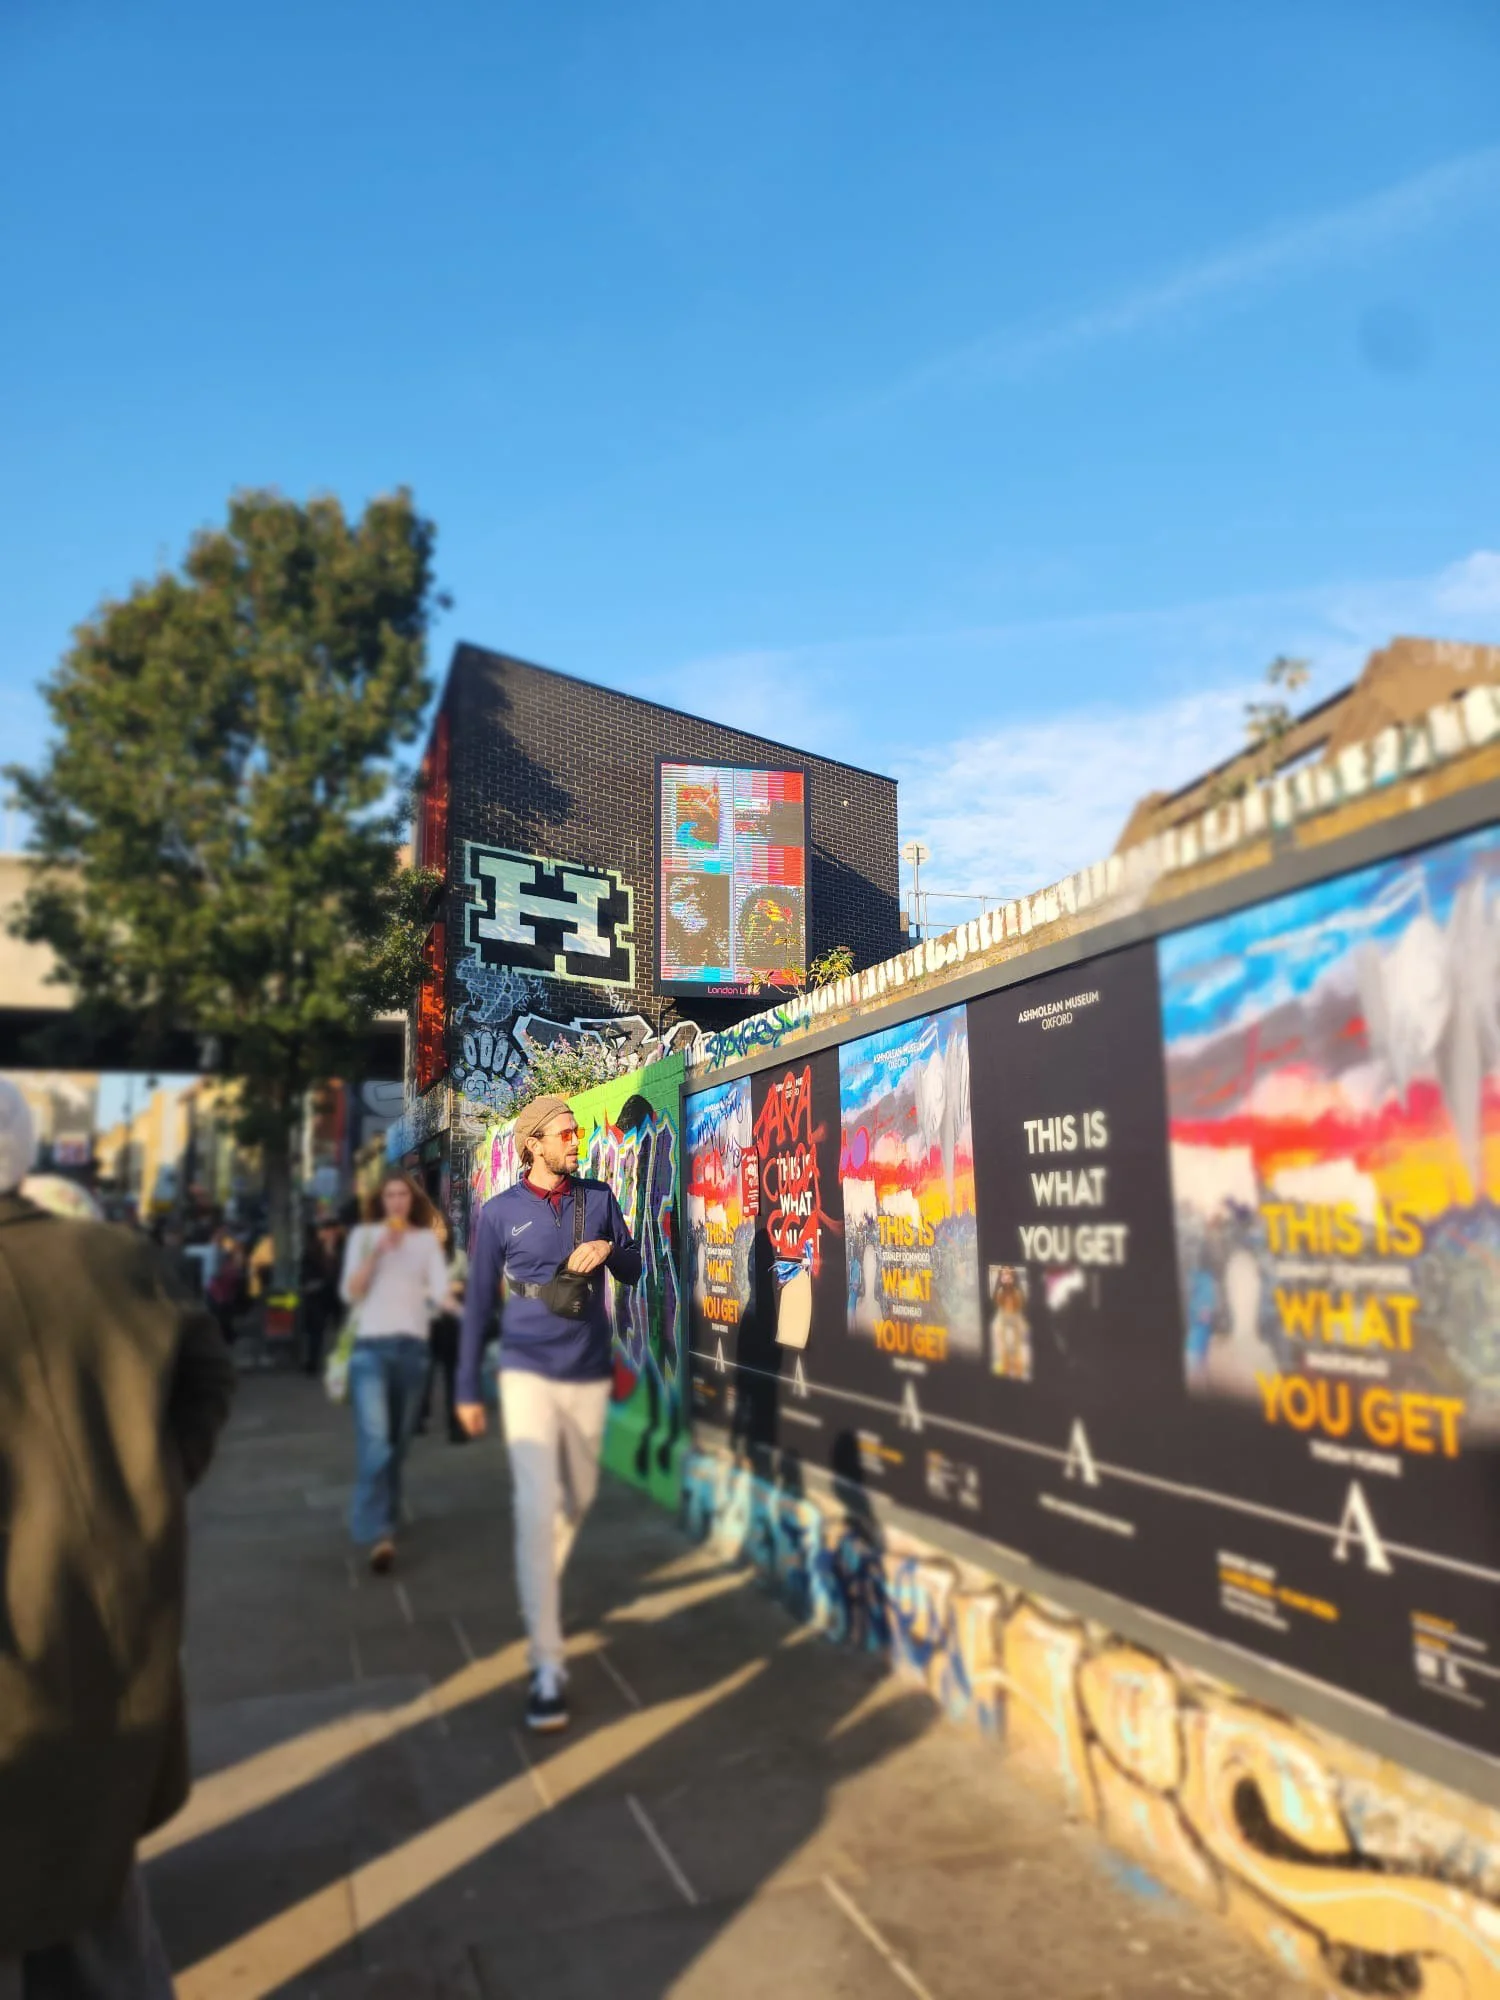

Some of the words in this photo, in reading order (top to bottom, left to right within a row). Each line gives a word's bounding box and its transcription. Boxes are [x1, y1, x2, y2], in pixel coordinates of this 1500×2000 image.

[472, 848, 624, 967] H
[708, 985, 738, 995] London
[1018, 1000, 1063, 1023] ASHMOLEAN
[1065, 990, 1099, 1010] MUSEUM
[1041, 1012, 1073, 1030] OXFORD
[1023, 1114, 1078, 1155] THIS
[1083, 1110, 1108, 1149] IS
[780, 1191, 813, 1217] WHAT
[1030, 1168, 1106, 1208] WHAT
[705, 1221, 724, 1244] THIS
[725, 1222, 735, 1245] IS
[878, 1215, 914, 1246] THIS
[917, 1215, 935, 1247] IS
[1018, 1225, 1071, 1263] YOU
[1075, 1224, 1129, 1265] GET
[1258, 1202, 1364, 1257] THIS
[1374, 1202, 1424, 1257] IS
[707, 1259, 733, 1283] WHAT
[881, 1268, 933, 1302] WHAT
[703, 1295, 720, 1320] YOU
[721, 1298, 740, 1324] GET
[1273, 1286, 1419, 1352] WHAT
[872, 1318, 909, 1354] YOU
[911, 1322, 949, 1362] GET
[1254, 1369, 1351, 1437] YOU
[1360, 1387, 1465, 1459] GET
[1331, 1480, 1394, 1574] A
